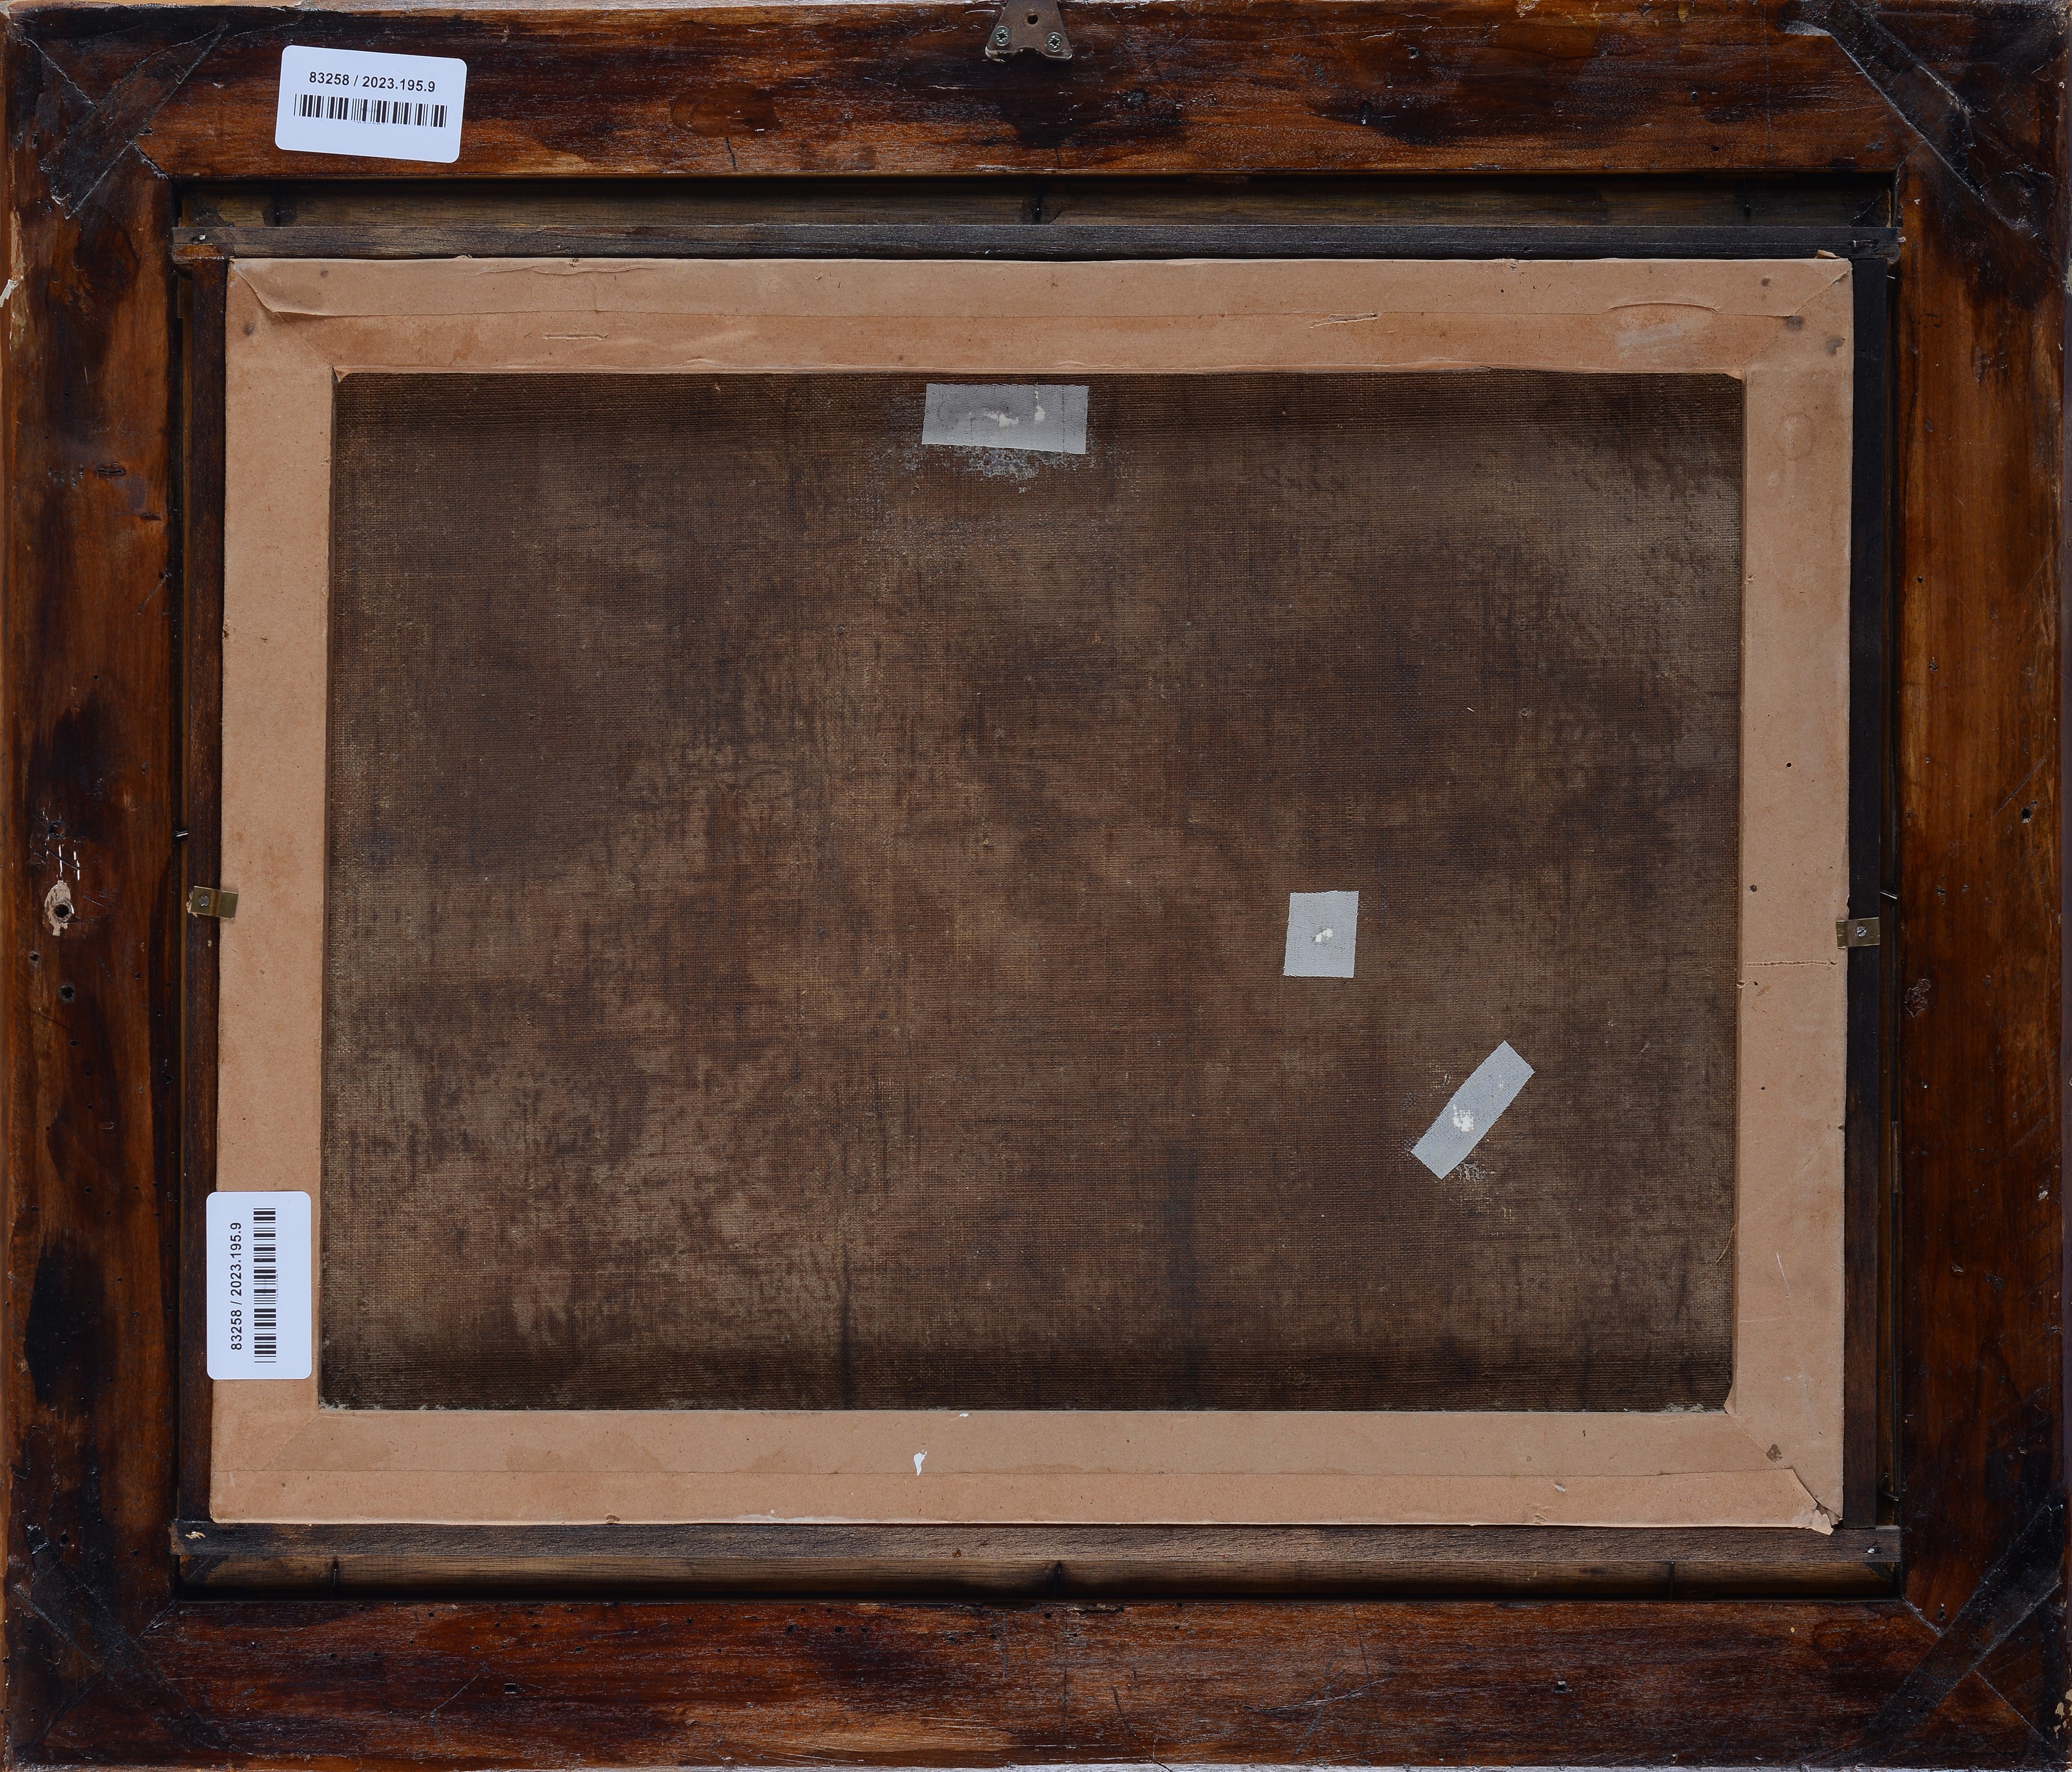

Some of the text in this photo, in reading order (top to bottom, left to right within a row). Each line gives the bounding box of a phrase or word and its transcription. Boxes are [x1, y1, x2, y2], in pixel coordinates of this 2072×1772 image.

[309, 72, 436, 93] 83258 / 2023.195.9
[229, 1222, 242, 1296] 2023.195.9
[230, 1309, 242, 1350] 83258
